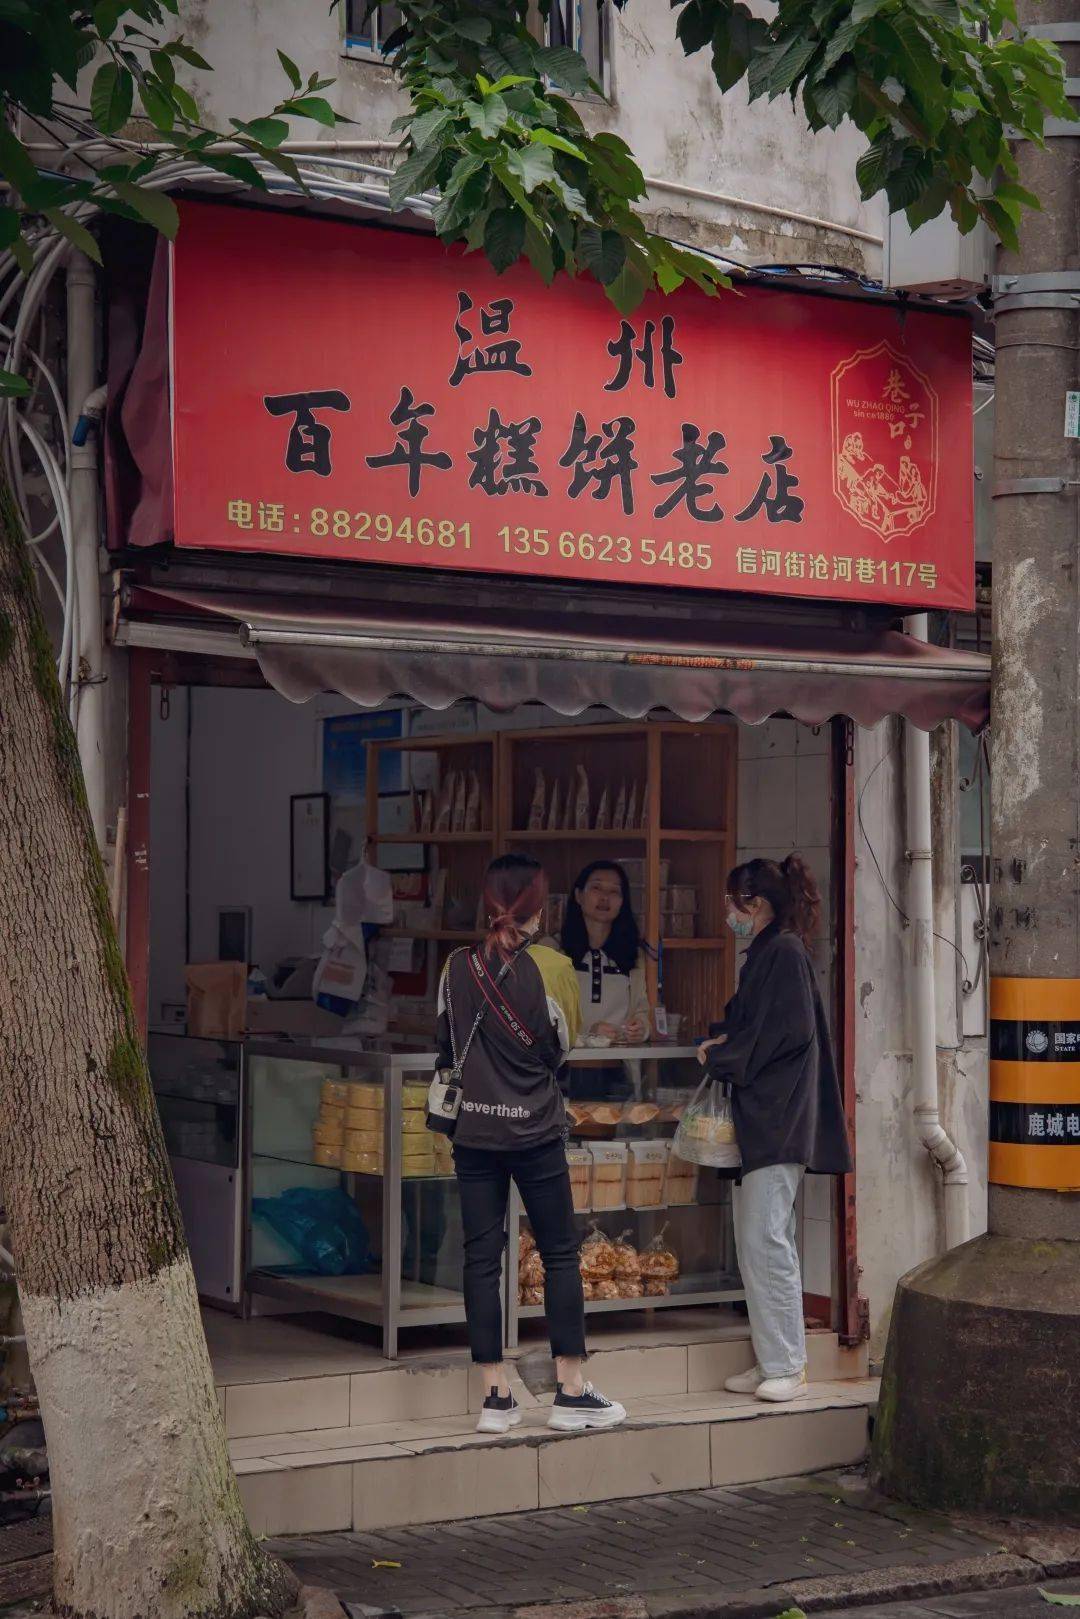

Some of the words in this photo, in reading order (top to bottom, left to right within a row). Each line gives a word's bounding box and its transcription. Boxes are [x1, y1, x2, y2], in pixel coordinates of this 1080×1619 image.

[846, 399, 860, 408] WU
[861, 400, 884, 411] ZHAO
[885, 403, 905, 414] QING
[263, 386, 805, 523] 百年糕饼老店
[558, 531, 632, 563] 6623
[640, 538, 713, 570] 5485
[735, 546, 938, 589] 信河街沧河巷117号
[517, 1030, 533, 1046] EOS
